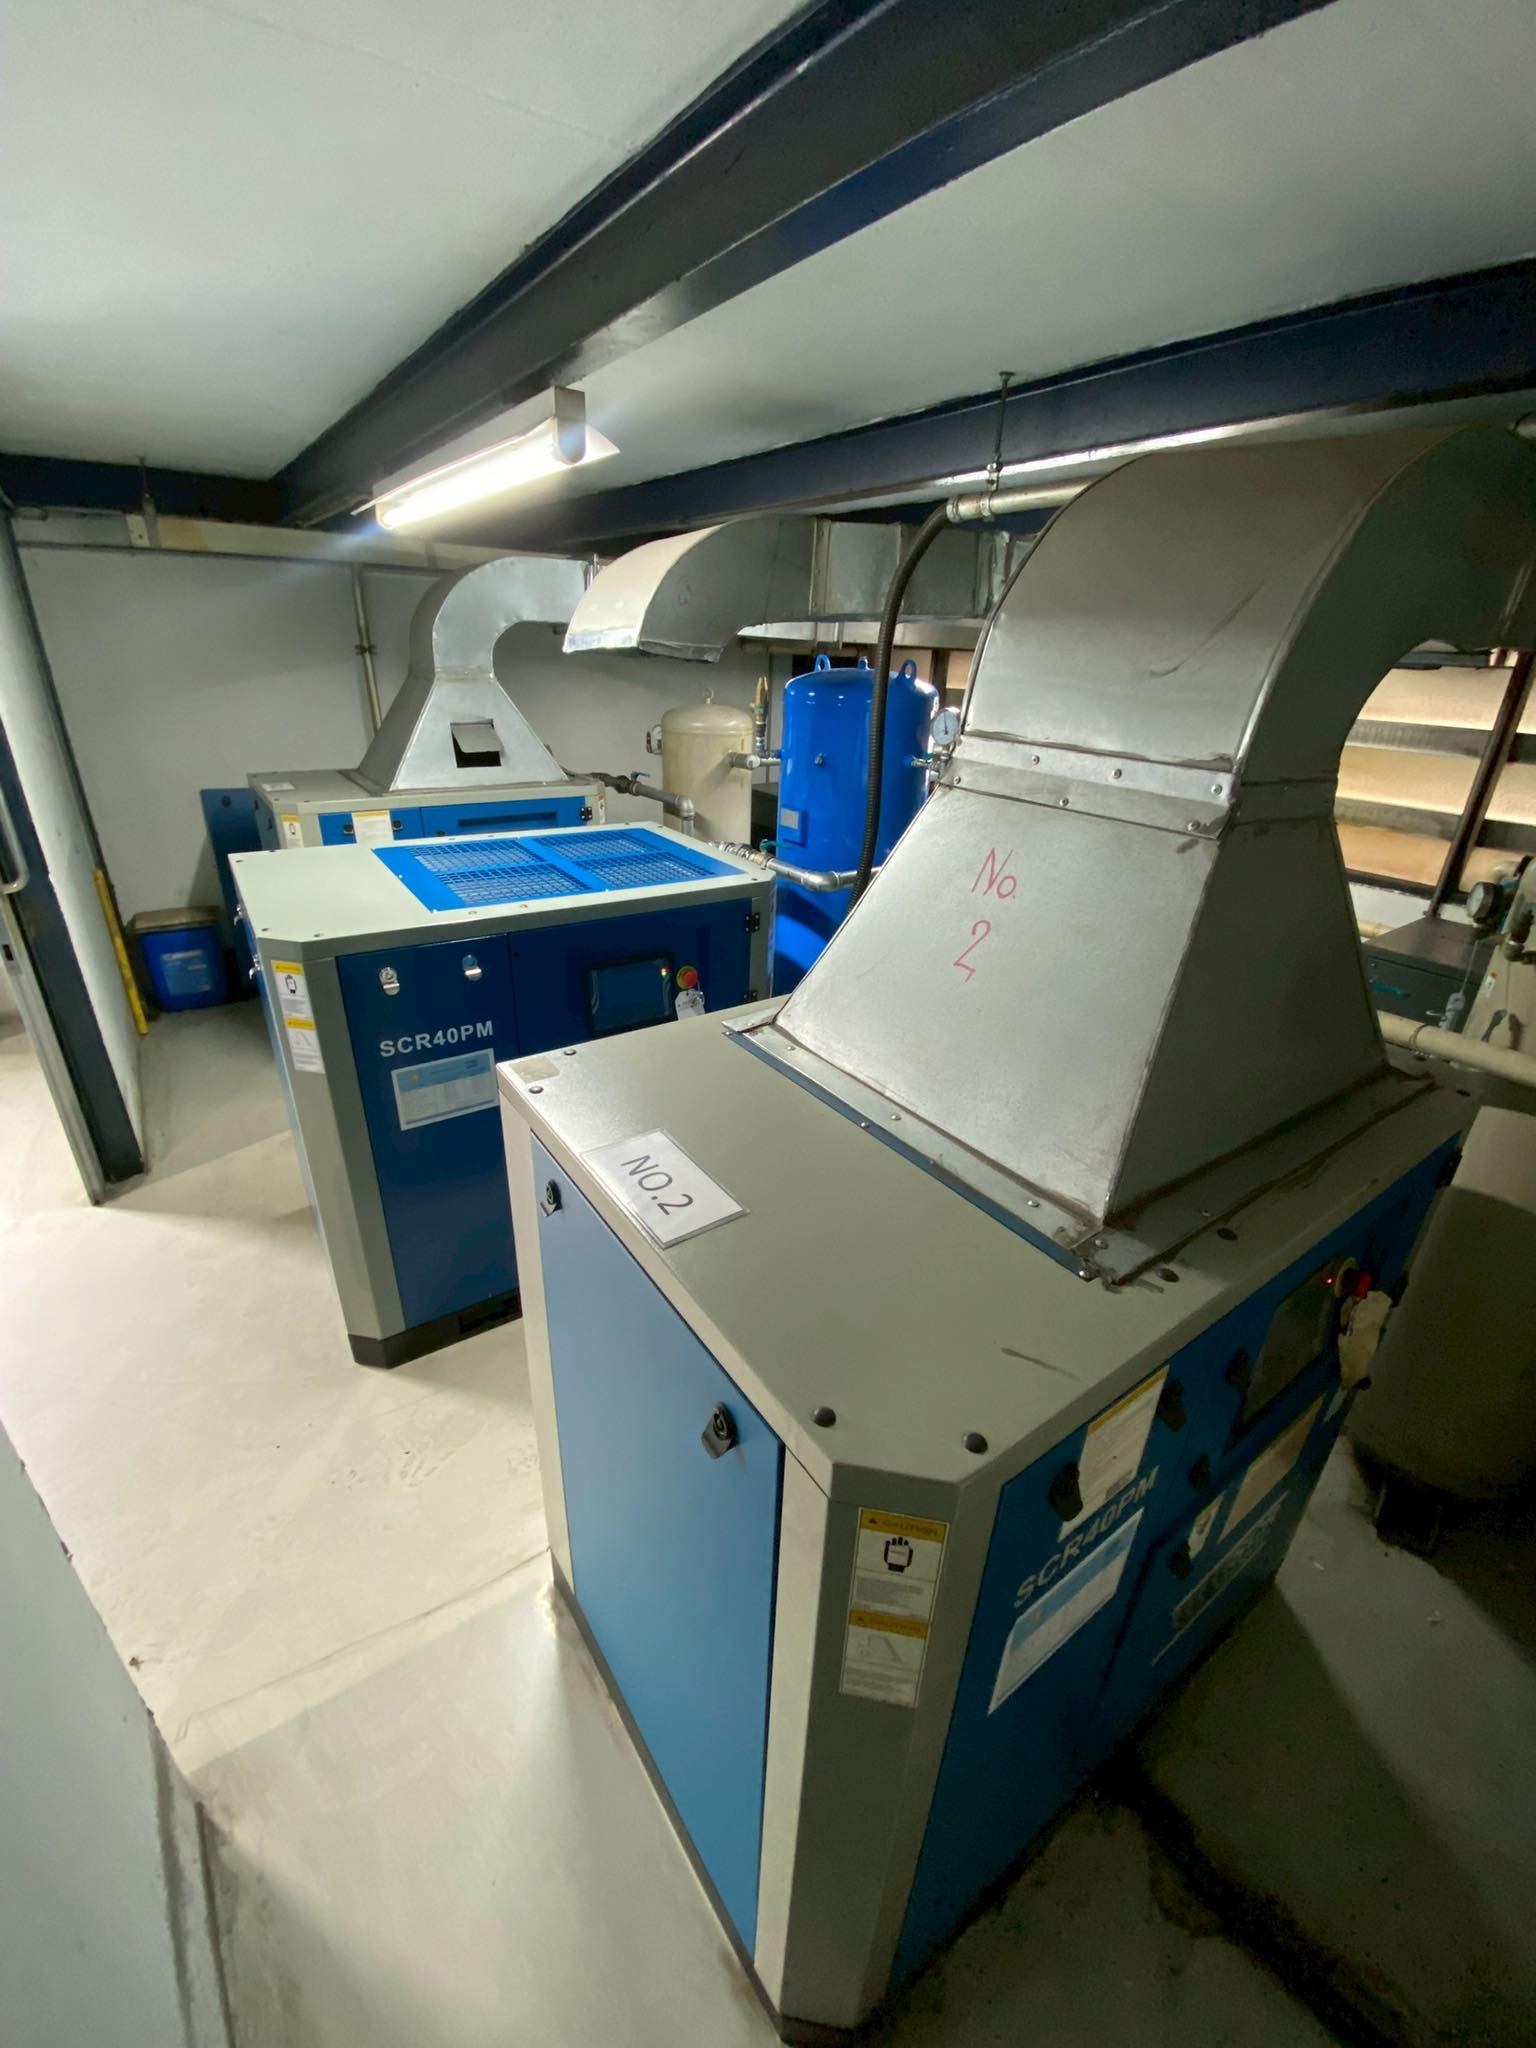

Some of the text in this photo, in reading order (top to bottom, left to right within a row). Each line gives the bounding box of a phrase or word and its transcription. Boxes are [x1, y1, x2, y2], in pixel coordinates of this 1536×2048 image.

[953, 919, 992, 983] 2
[379, 1020, 494, 1058] SCR40PM
[620, 1154, 694, 1216] NO.2
[1013, 1464, 1160, 1610] SCR40PM
